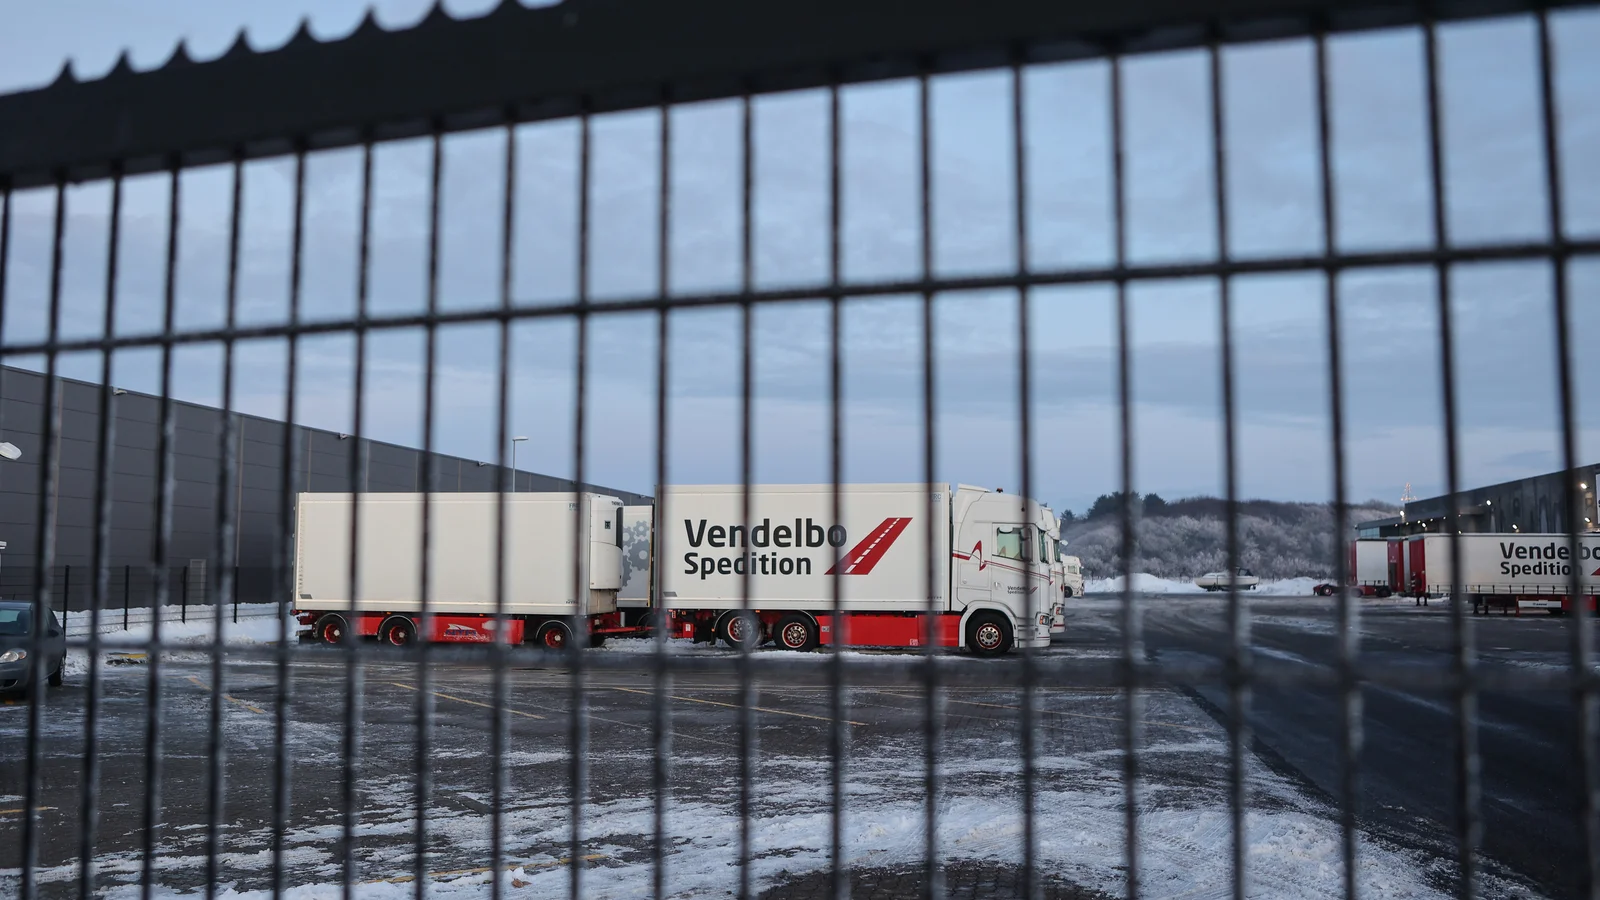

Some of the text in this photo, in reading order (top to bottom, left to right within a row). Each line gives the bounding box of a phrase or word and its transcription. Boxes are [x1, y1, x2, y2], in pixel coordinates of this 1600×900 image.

[684, 518, 847, 548] Vendelbo
[1500, 542, 1600, 560] Vendebo
[684, 552, 811, 580] Spedition
